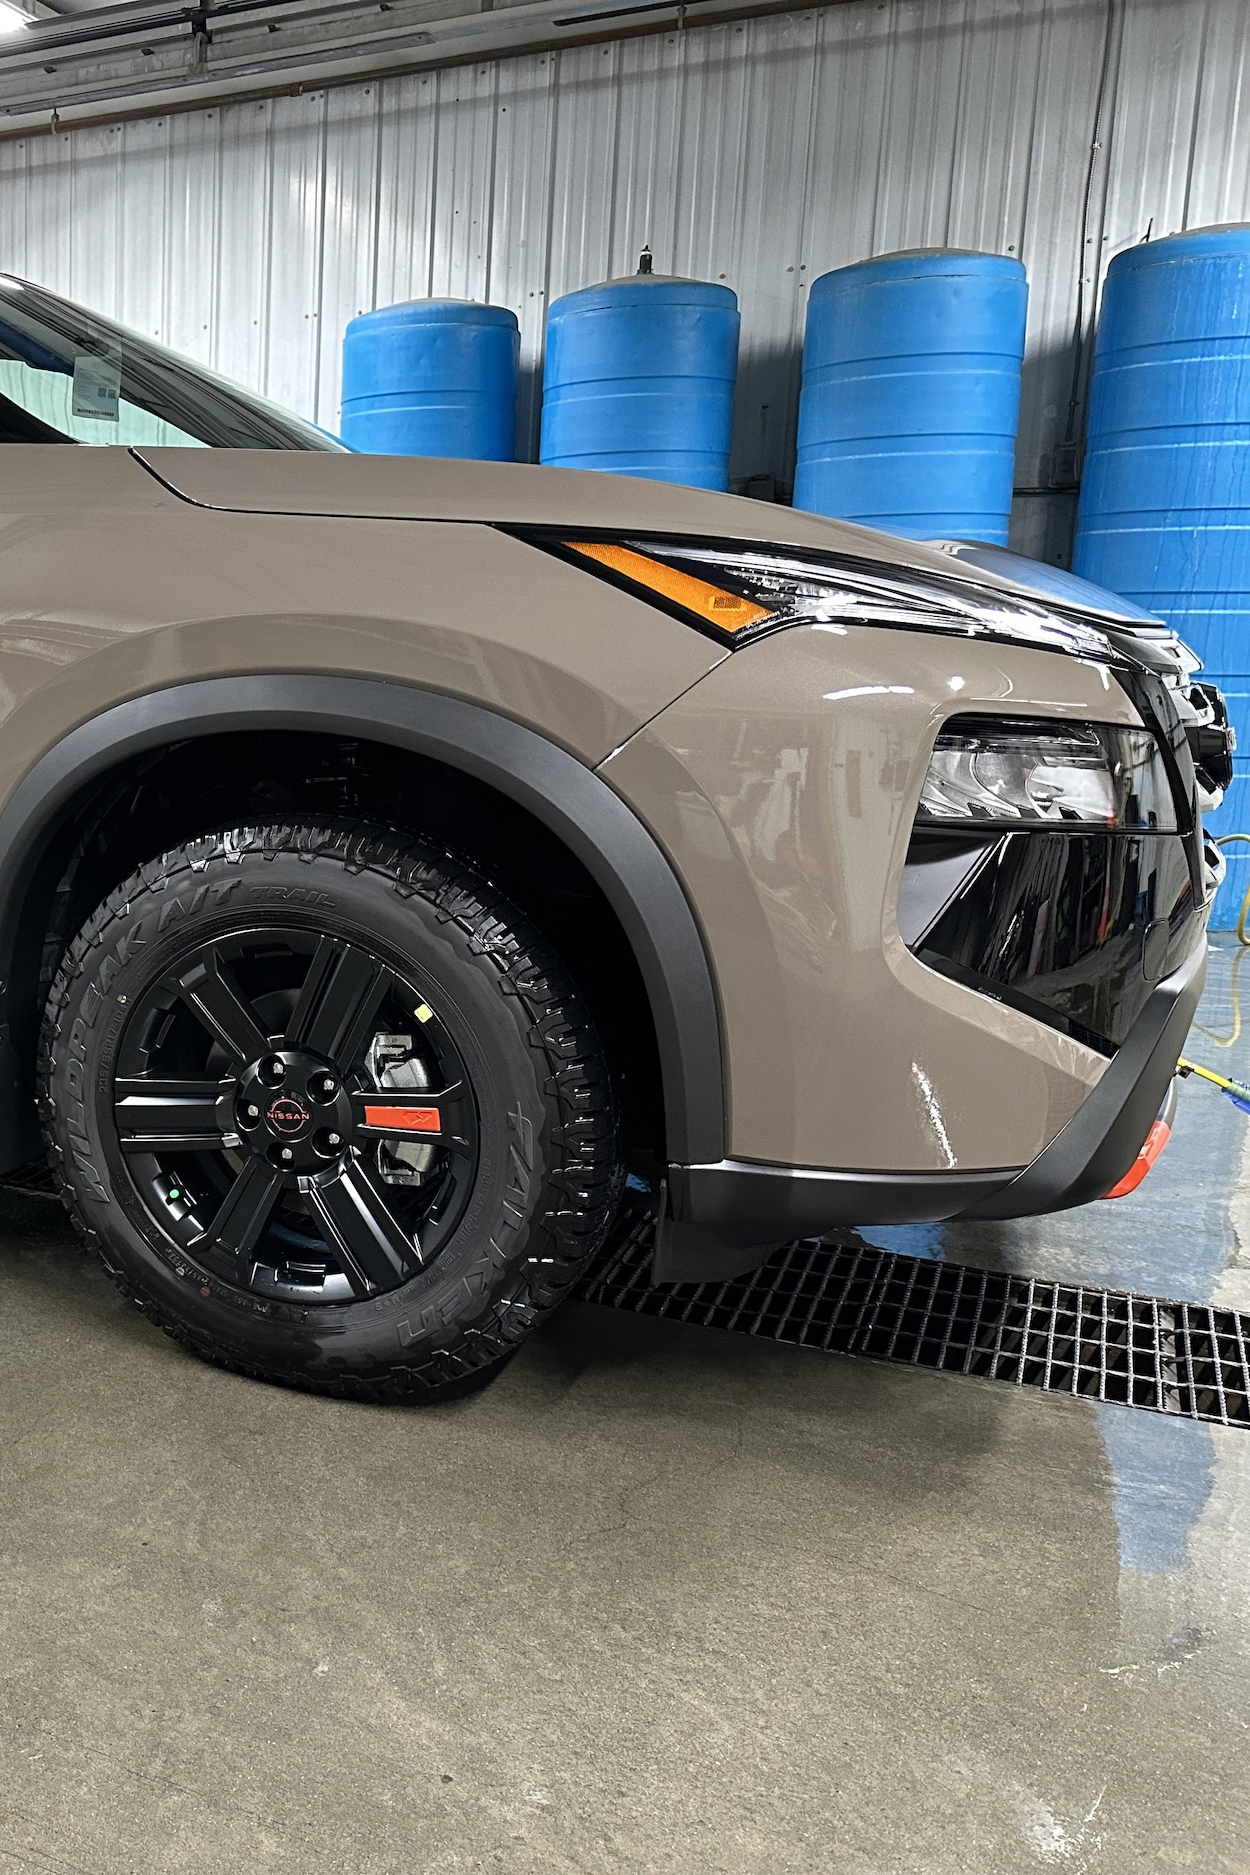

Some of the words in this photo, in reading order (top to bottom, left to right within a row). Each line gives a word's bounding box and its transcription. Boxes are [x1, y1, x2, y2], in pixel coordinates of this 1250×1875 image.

[65, 920, 147, 1203] WILDPEAK
[250, 886, 336, 908] TRAIL
[267, 1111, 310, 1120] NISSAN
